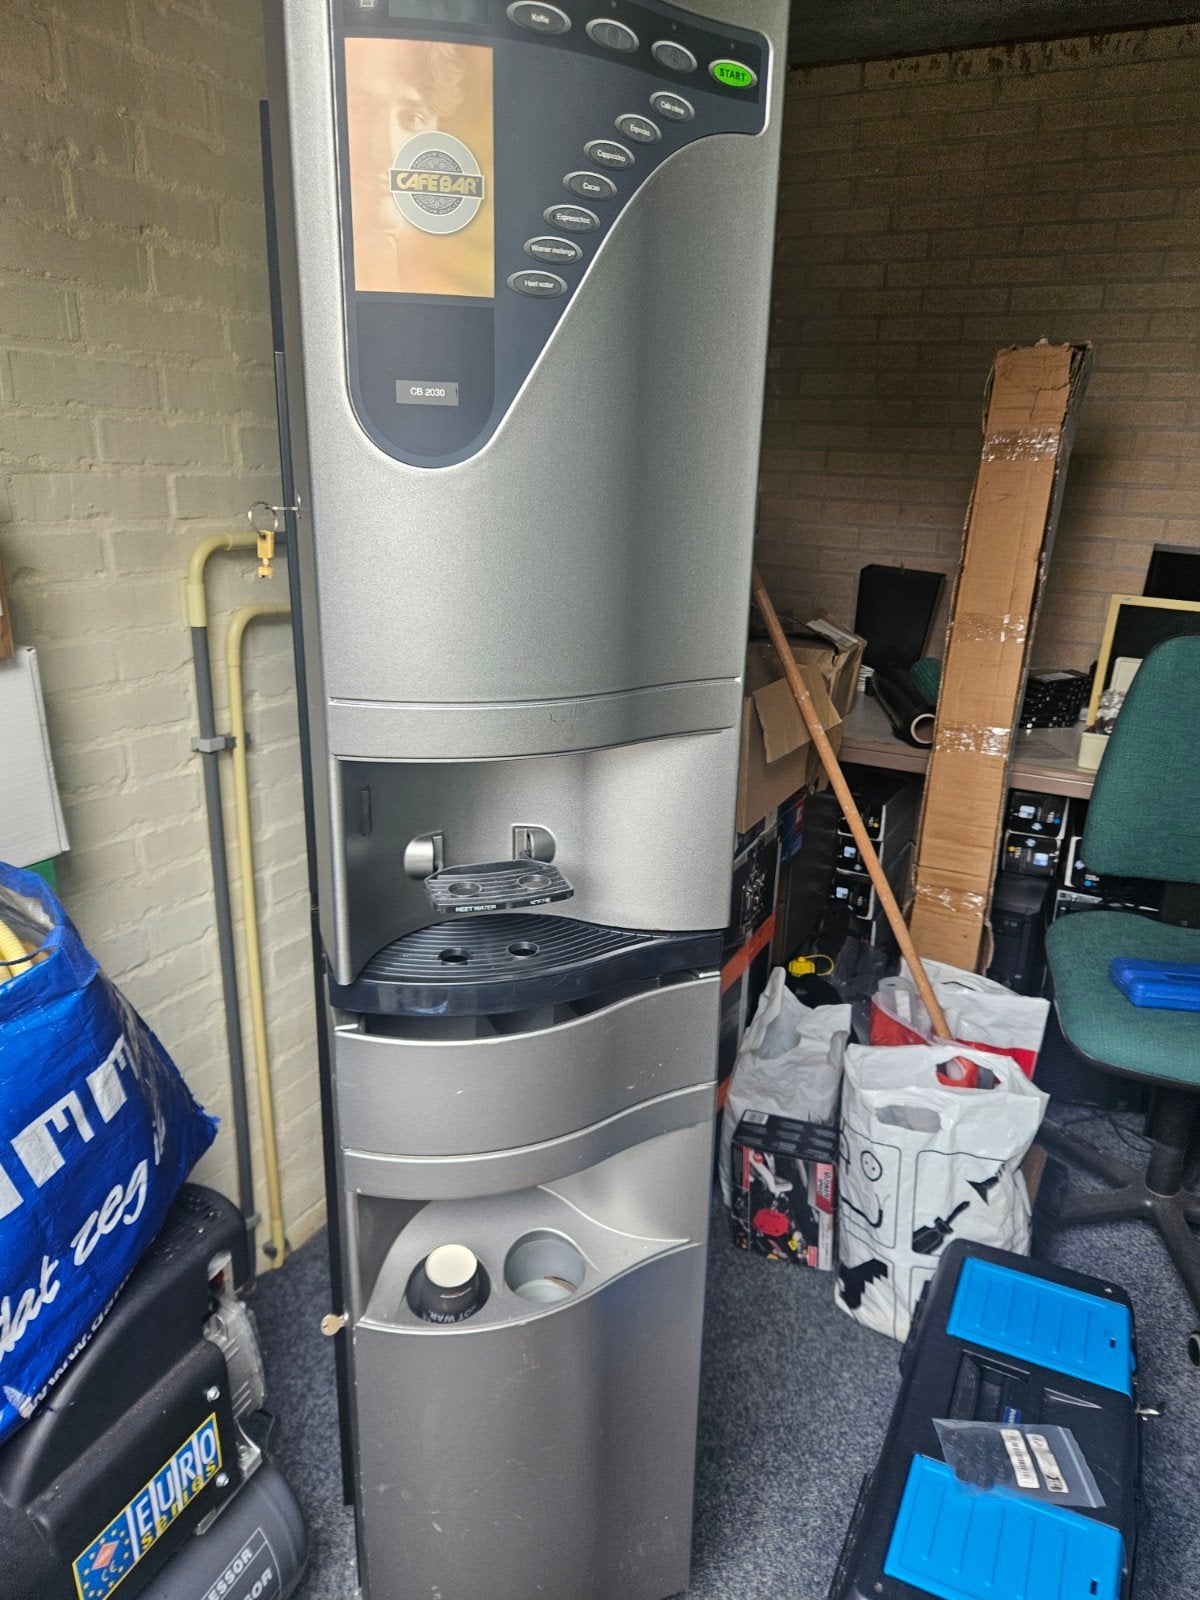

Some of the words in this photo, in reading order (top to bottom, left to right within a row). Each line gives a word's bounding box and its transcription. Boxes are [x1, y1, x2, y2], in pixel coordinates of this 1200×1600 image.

[531, 13, 550, 24] Koffie
[719, 67, 747, 82] START
[629, 123, 651, 138] Espresso
[597, 149, 626, 163] Cappuccino
[582, 182, 601, 192] Cacao
[539, 281, 554, 289] water
[410, 387, 423, 396] CB
[425, 388, 445, 397] 2030
[70, 1158, 148, 1266] zeg
[135, 1428, 217, 1537] EURO
[141, 1460, 217, 1551] series
